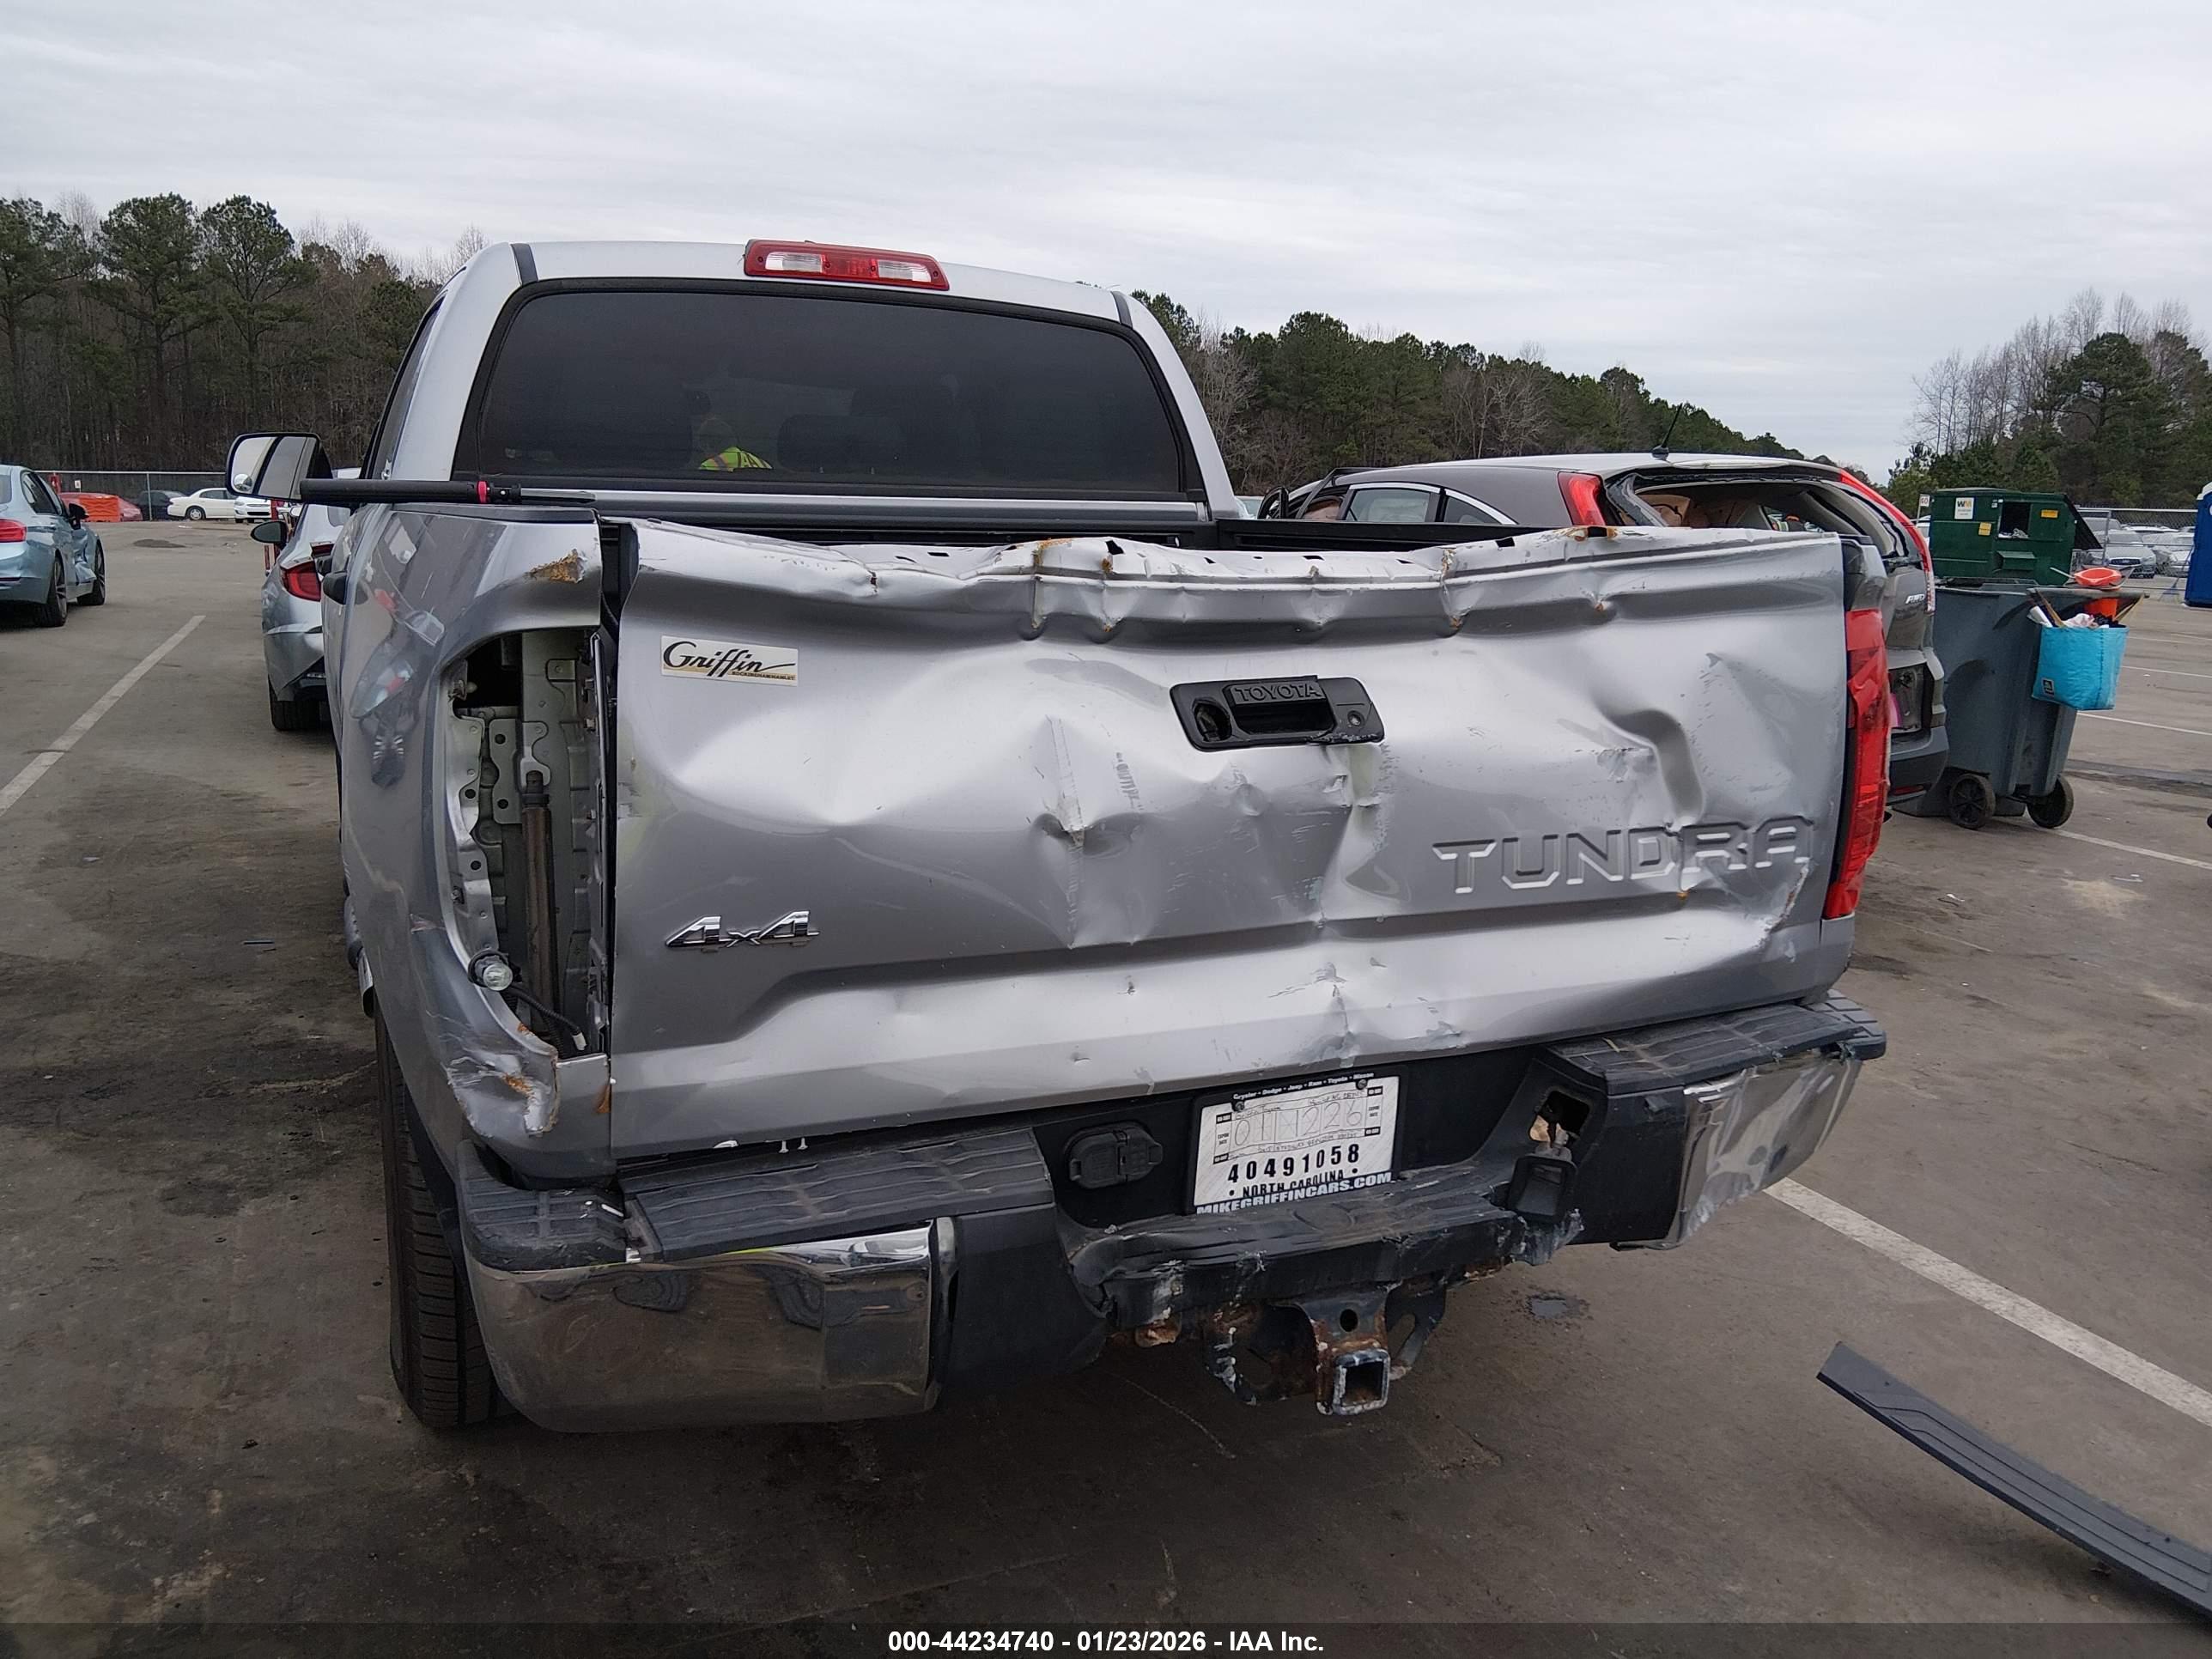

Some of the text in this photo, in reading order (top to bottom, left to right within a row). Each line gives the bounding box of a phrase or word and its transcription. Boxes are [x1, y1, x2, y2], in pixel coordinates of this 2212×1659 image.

[663, 641, 796, 678] Griffin
[1235, 684, 1322, 702] TOYOTA
[1432, 815, 1814, 894] TUNDRA
[665, 911, 819, 948] 4x4
[1228, 1144, 1359, 1183] 40491058
[1196, 1171, 1393, 1215] MIKEGRIFFINCARS.COM
[1243, 1170, 1345, 1198] NORTH CAROLINA
